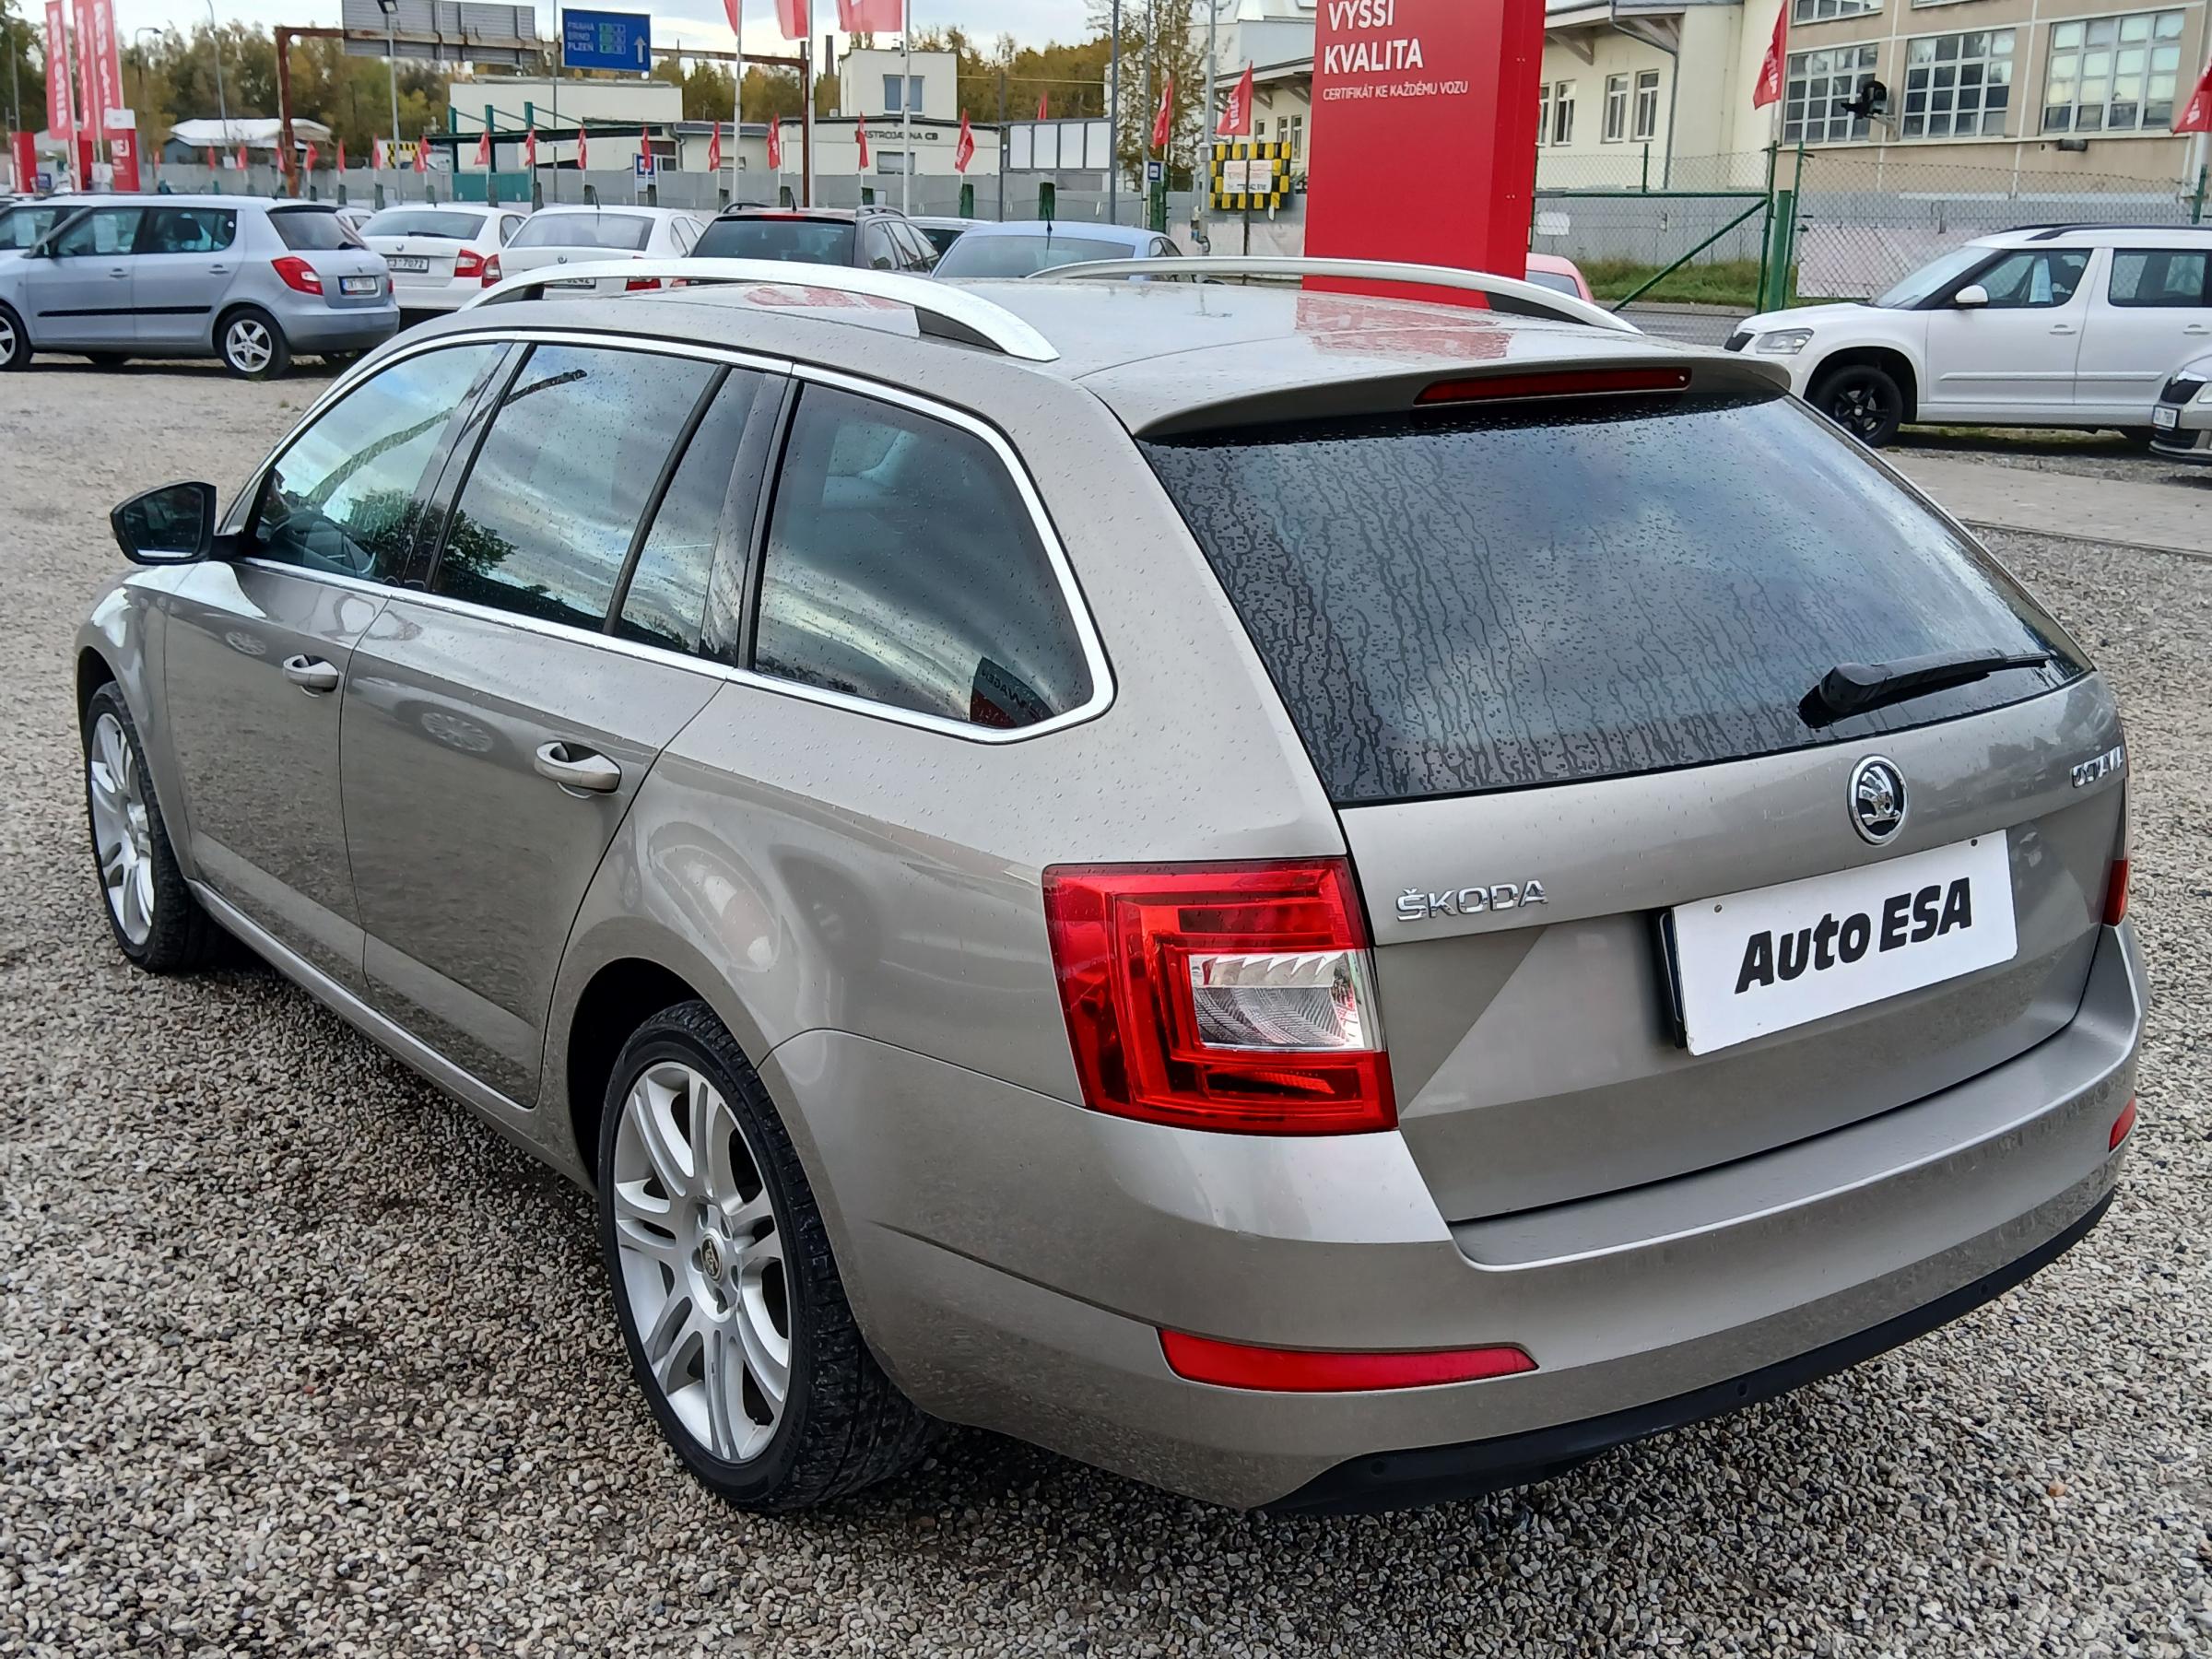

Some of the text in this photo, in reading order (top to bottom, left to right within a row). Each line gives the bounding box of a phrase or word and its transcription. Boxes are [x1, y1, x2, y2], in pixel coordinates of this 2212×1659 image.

[1324, 38, 1424, 75] KVALITA
[1323, 80, 1469, 101] CERTIFIKÁT KE KAŽDÉMU VOZU
[1396, 879, 1549, 922] ŠKODA
[1735, 877, 1972, 994] Auto ESA
